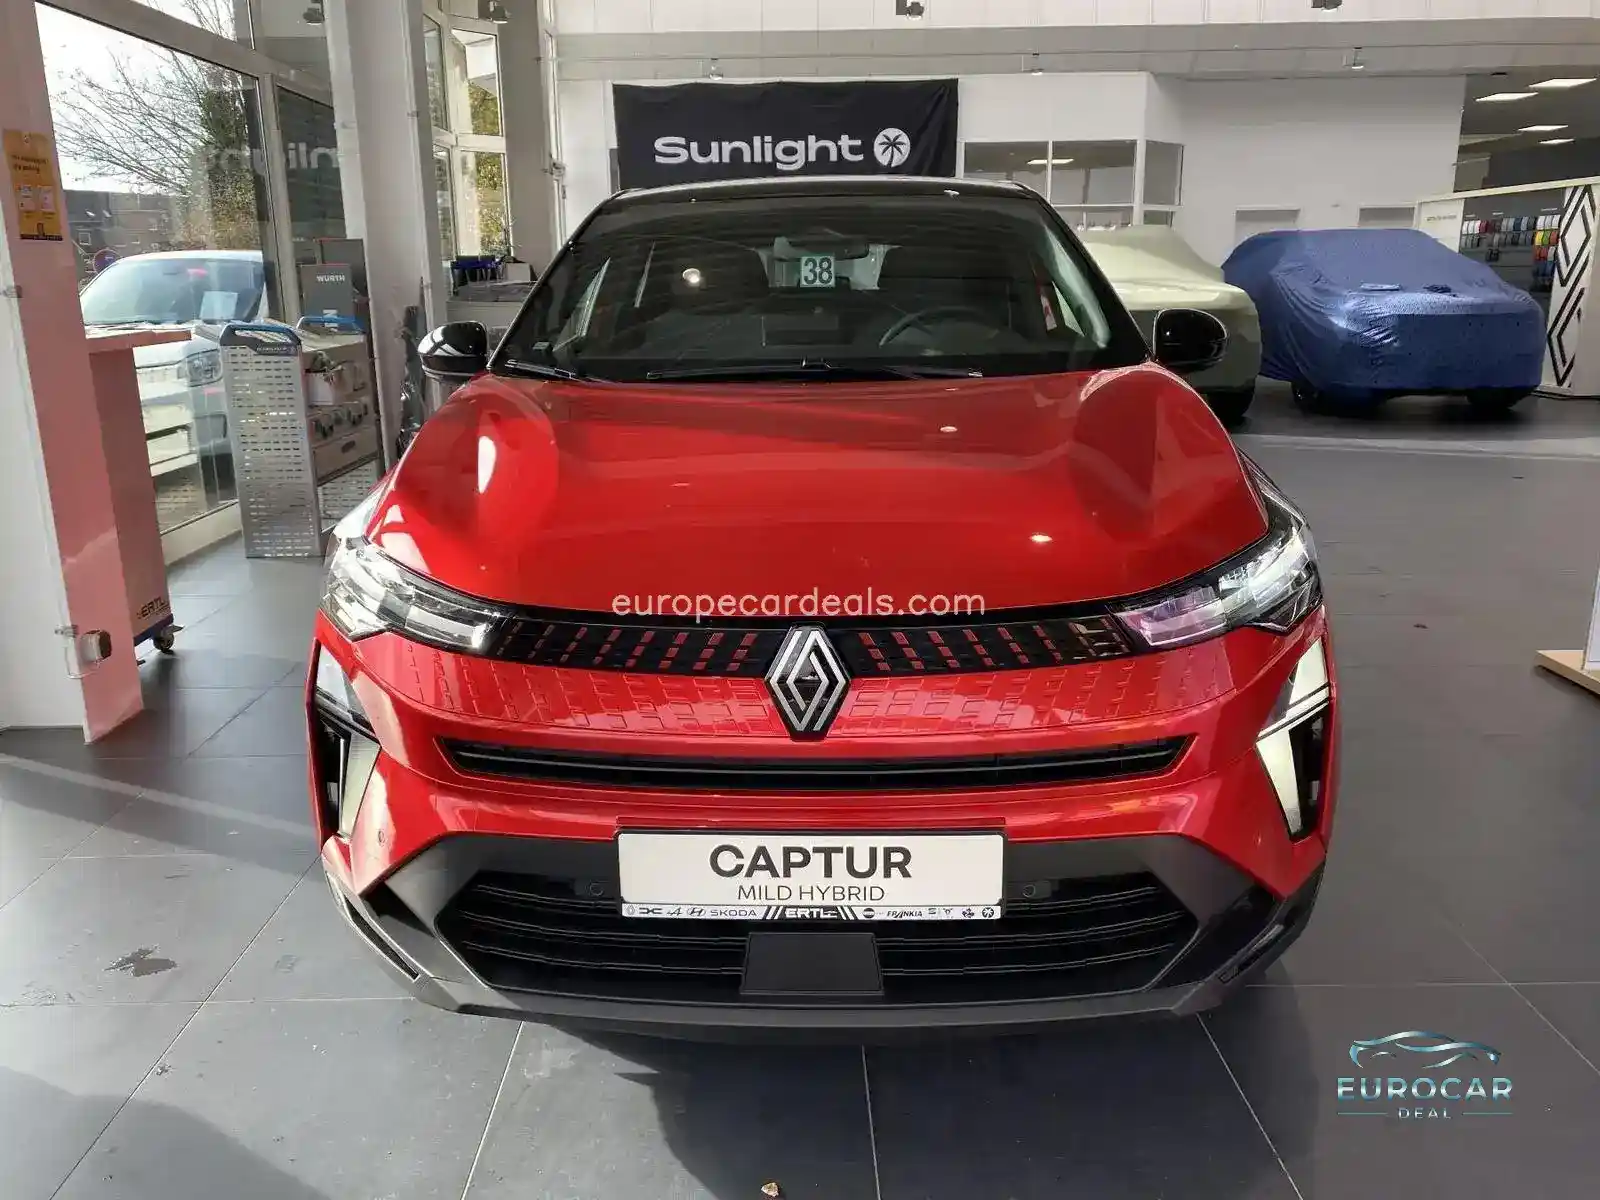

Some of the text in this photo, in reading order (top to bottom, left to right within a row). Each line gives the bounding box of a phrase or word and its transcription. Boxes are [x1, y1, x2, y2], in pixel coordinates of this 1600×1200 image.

[653, 134, 864, 171] Sunlight
[803, 257, 833, 285] 38
[709, 844, 912, 879] CAPTUR
[737, 884, 885, 901] MILD HYBRID
